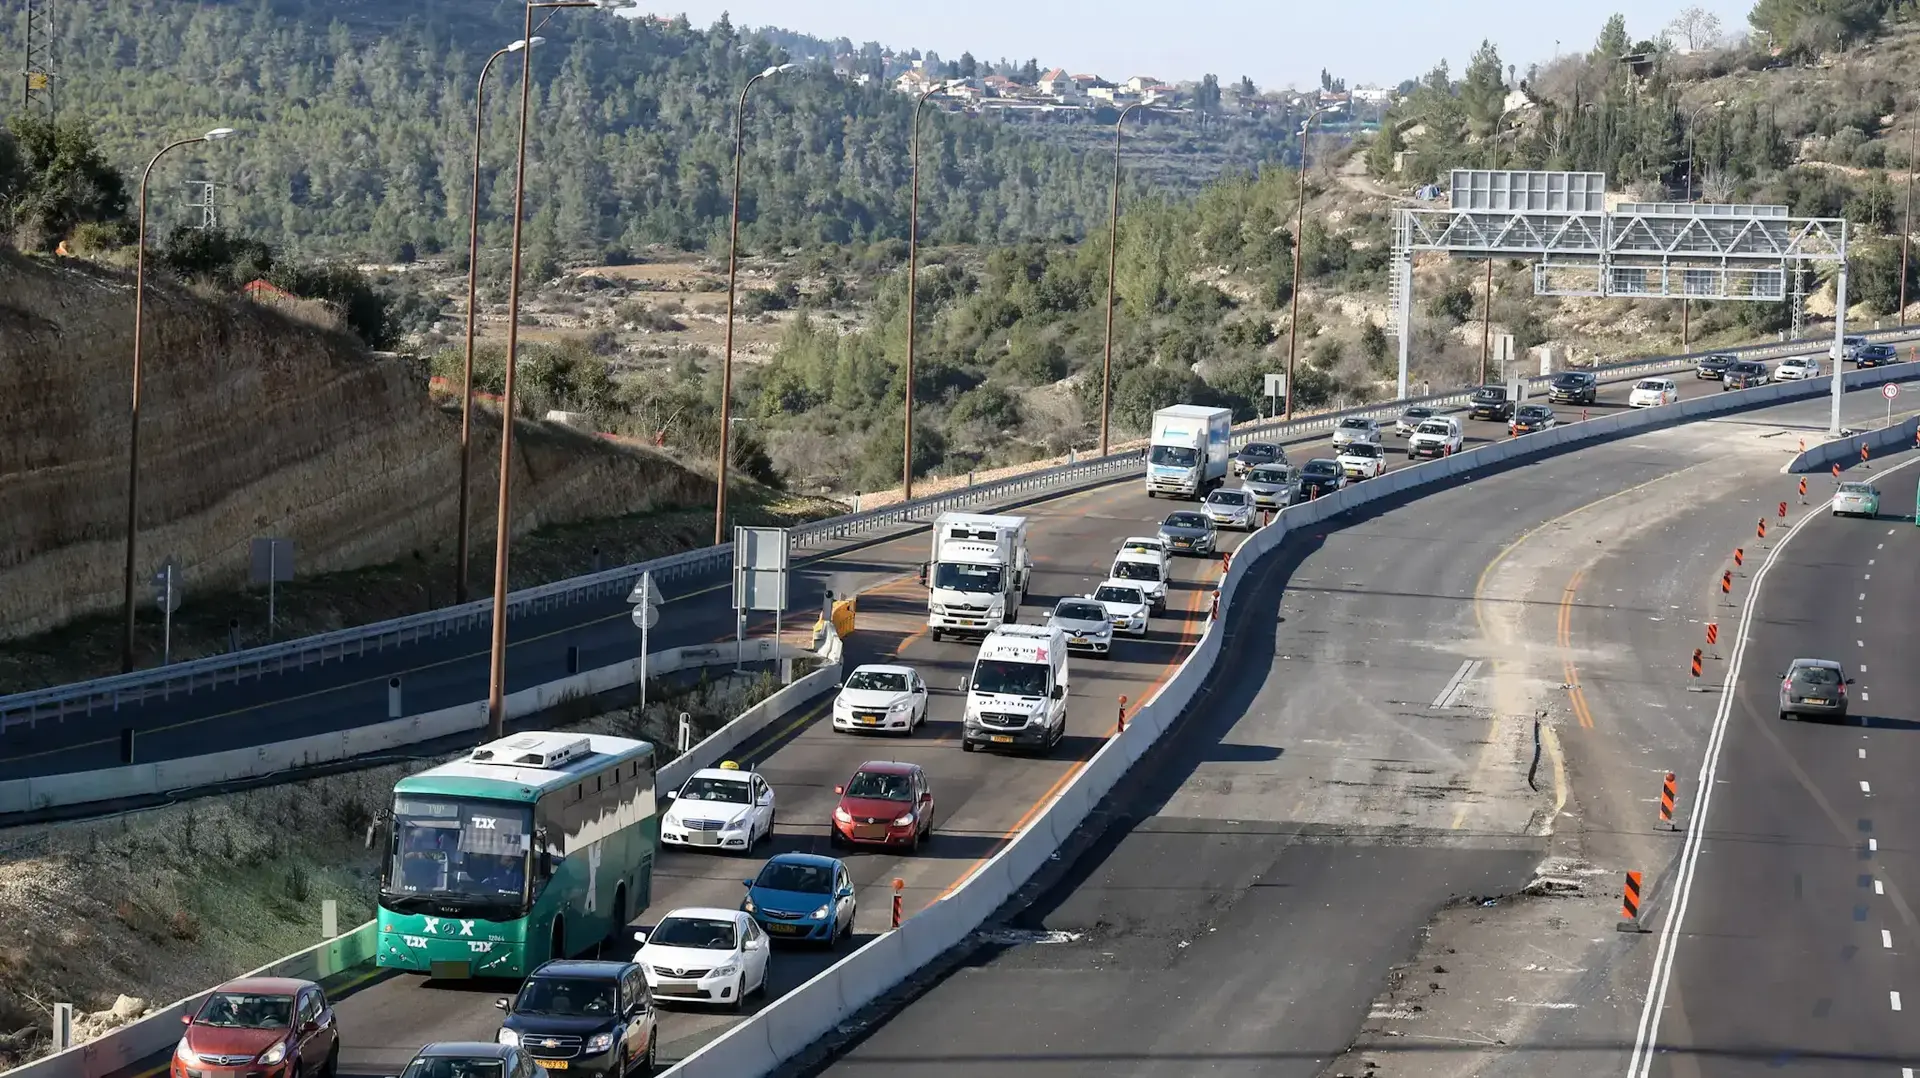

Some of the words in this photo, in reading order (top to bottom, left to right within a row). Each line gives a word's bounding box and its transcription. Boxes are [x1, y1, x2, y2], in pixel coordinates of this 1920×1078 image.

[1886, 387, 1895, 395] 70
[471, 817, 497, 830] אגד
[403, 936, 428, 949] אגד
[467, 941, 493, 953] אגד
